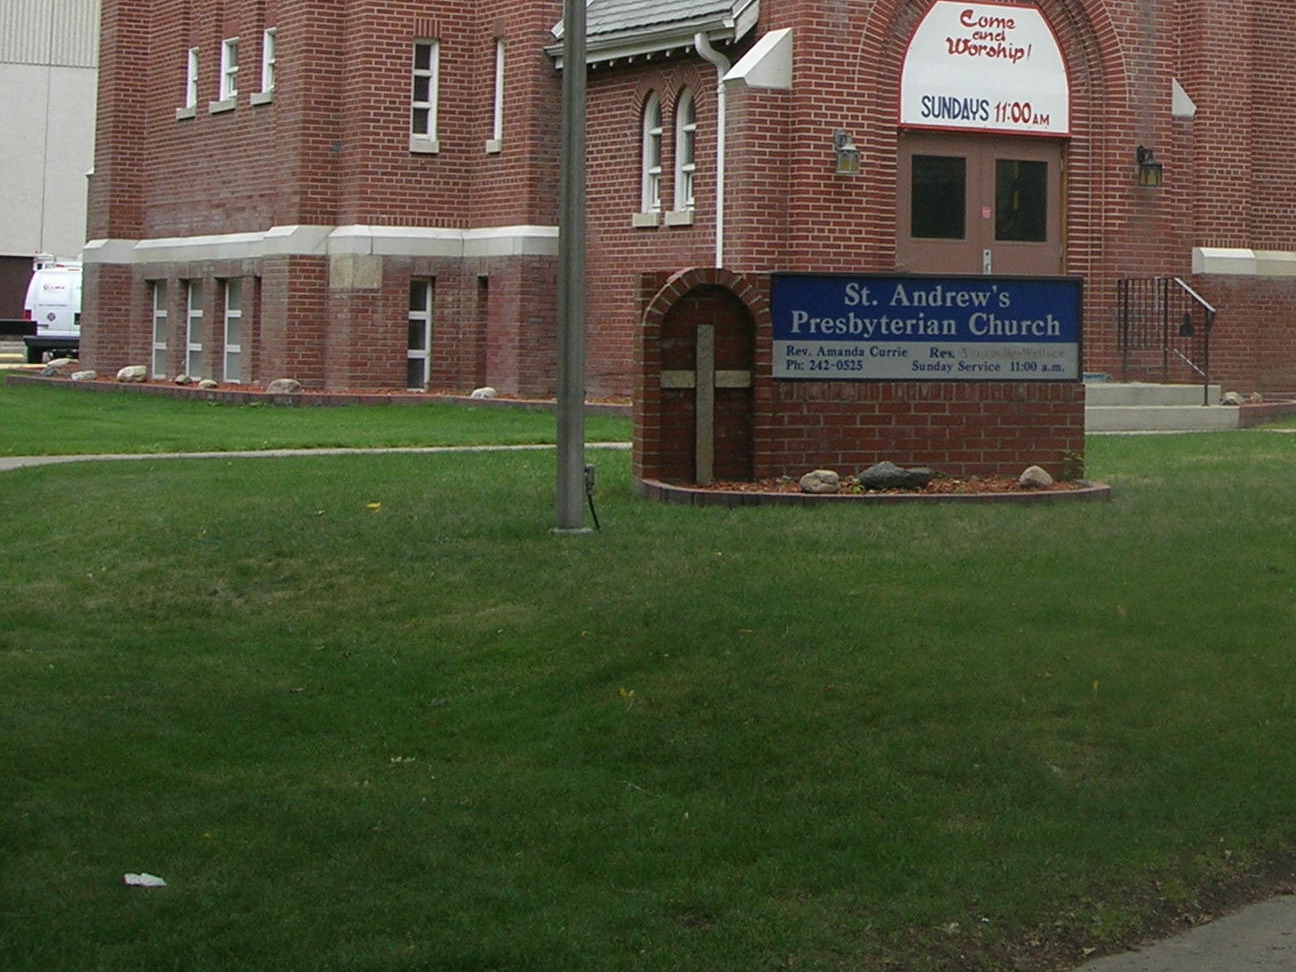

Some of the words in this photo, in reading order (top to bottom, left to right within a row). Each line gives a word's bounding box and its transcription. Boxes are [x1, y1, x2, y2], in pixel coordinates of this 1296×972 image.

[960, 9, 1016, 29] Come
[972, 30, 1006, 42] and
[945, 36, 1032, 64] Worship!
[921, 95, 989, 122] SUNDAYS
[994, 102, 1032, 124] 11:00
[1032, 114, 1050, 126] AM
[844, 283, 878, 307] St.
[890, 284, 1011, 308] Andrew's
[790, 310, 957, 338] Presbyterian
[968, 312, 1061, 337] Church
[786, 345, 812, 357] Rev.
[817, 346, 865, 358] Amanda
[869, 346, 908, 358] Currie
[786, 360, 804, 371] Ph:
[809, 360, 863, 372] 242-0525
[912, 360, 954, 373] Sunday
[958, 361, 1000, 372] Service
[1011, 361, 1037, 372] 11:00
[1042, 363, 1065, 372] a.m.
